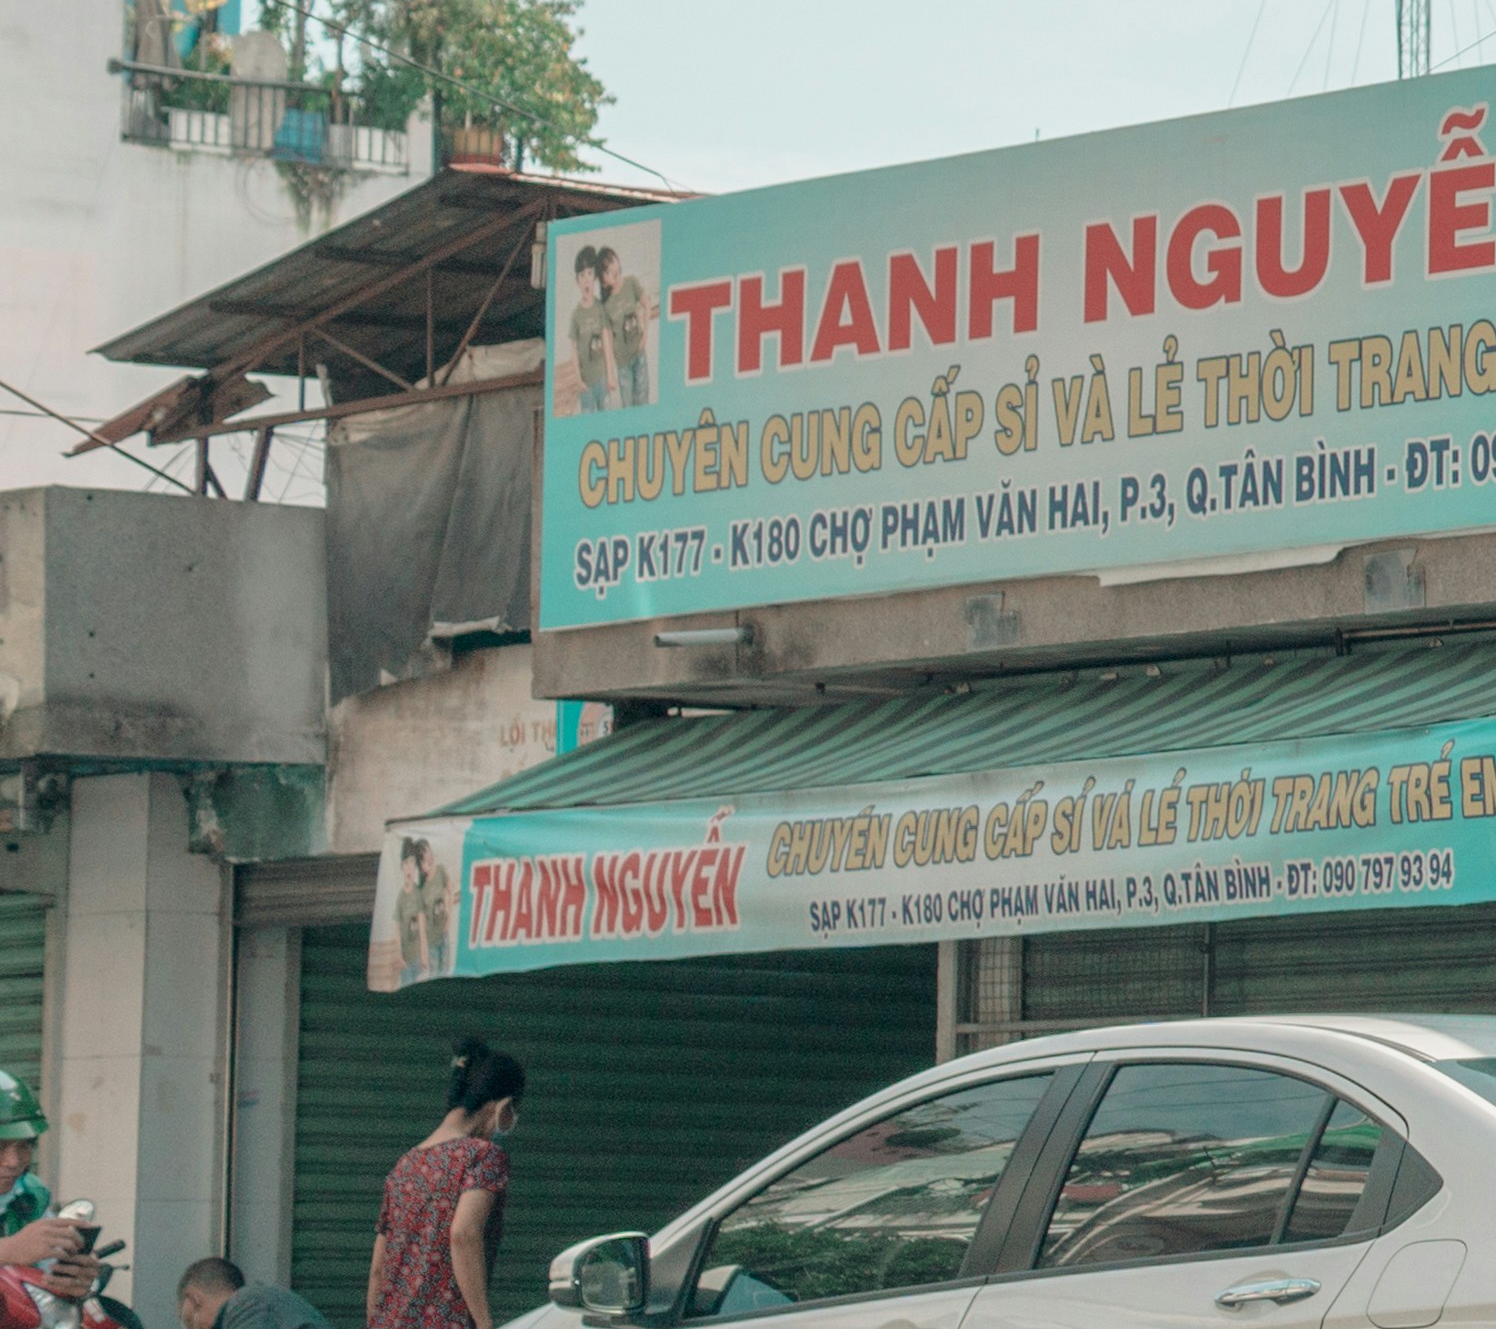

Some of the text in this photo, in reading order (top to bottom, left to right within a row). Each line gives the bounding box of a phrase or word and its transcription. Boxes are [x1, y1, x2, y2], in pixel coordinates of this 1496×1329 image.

[671, 234, 1039, 379] THANH
[578, 408, 749, 507] CHUYÊN
[760, 403, 881, 483] CUNG
[895, 366, 983, 467] CẤP
[995, 355, 1039, 456] SỈ
[1053, 355, 1113, 446] VÀ
[1128, 334, 1183, 436] LẺ
[1198, 330, 1314, 426] THỜI
[575, 537, 629, 597] SẠP
[637, 528, 706, 580] K177
[730, 516, 801, 567] K180
[809, 504, 874, 565] CHỢ
[882, 498, 965, 561] PHẠM
[976, 479, 1038, 539] VĂN
[1048, 479, 1109, 535] HAI,
[1119, 474, 1175, 528] P.3,
[1186, 449, 1283, 518] Q.TÂN
[1295, 441, 1375, 501] BÌNH
[1406, 438, 1460, 489] ĐT:
[469, 807, 745, 948] THANH NGUYỄN
[894, 807, 977, 867] CUNG
[984, 782, 1045, 859] CẤP
[1272, 768, 1377, 835] TRANG
[809, 898, 841, 938] SẠP
[845, 897, 886, 928] K177
[901, 893, 943, 926] K180
[947, 888, 986, 928] CHỢ
[990, 882, 1038, 925] PHẠM
[1044, 873, 1080, 914] VĂN
[1085, 880, 1121, 915] HAI,
[1126, 879, 1159, 912] P.3,
[1164, 860, 1220, 908] Q.TÂN
[1225, 857, 1271, 900] BÌNH
[1288, 863, 1317, 897] ĐT:
[1323, 861, 1354, 893] 090
[1361, 858, 1395, 890] 797
[1400, 856, 1424, 888] 93
[1428, 852, 1453, 885] 94
